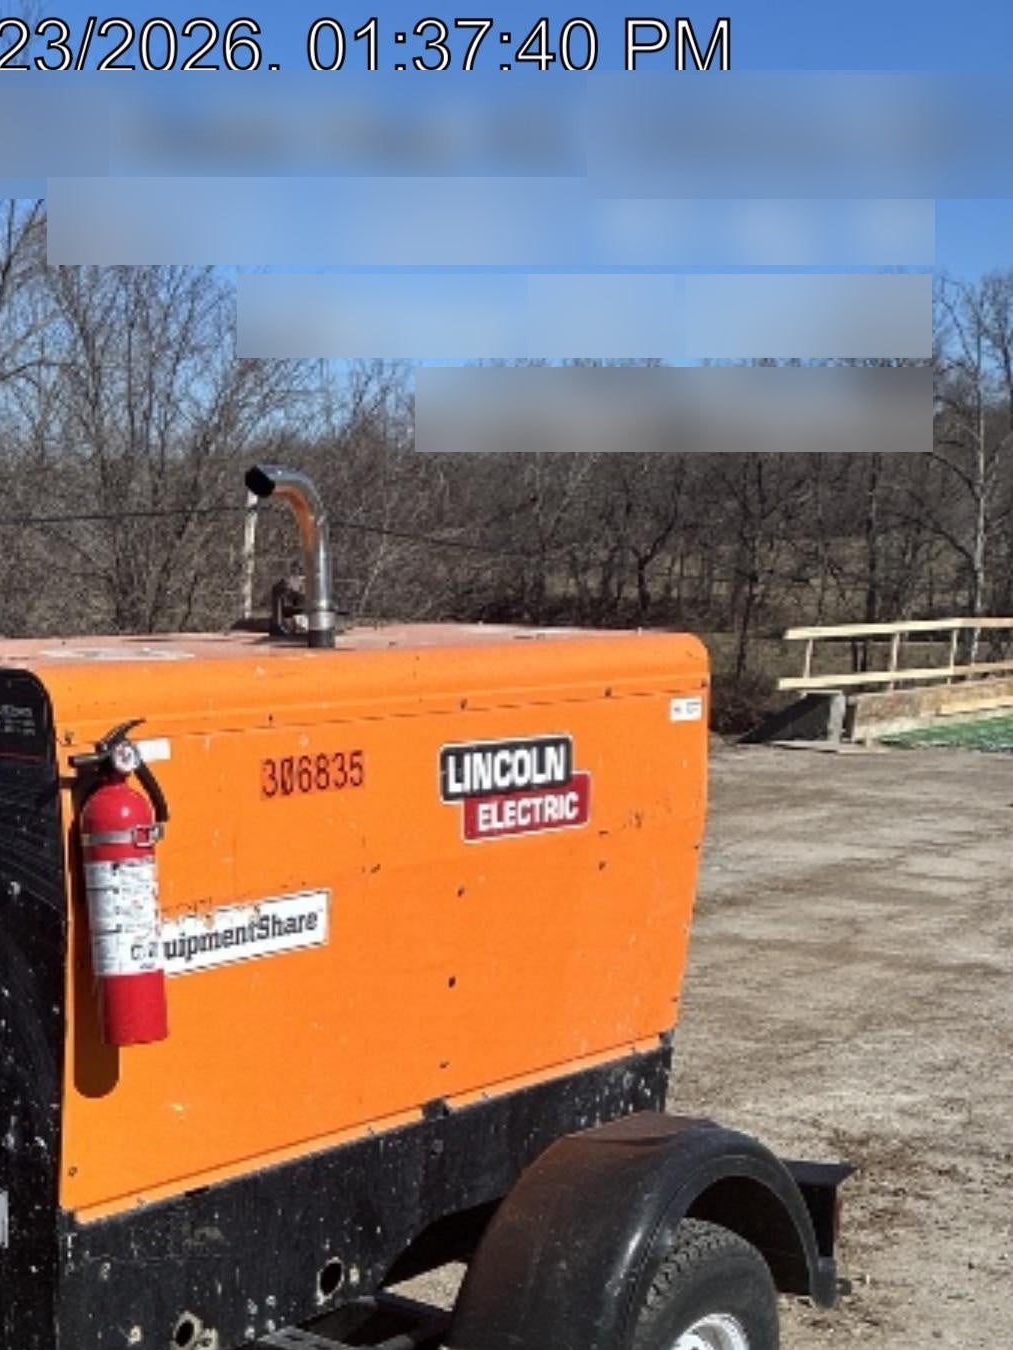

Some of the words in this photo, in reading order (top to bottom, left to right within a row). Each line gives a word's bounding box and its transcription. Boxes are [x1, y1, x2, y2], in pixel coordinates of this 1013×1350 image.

[262, 750, 364, 798] 306835
[447, 744, 566, 793] LINCOLN
[477, 791, 580, 832] ELECTRIC
[163, 910, 319, 962] uipmentShare
